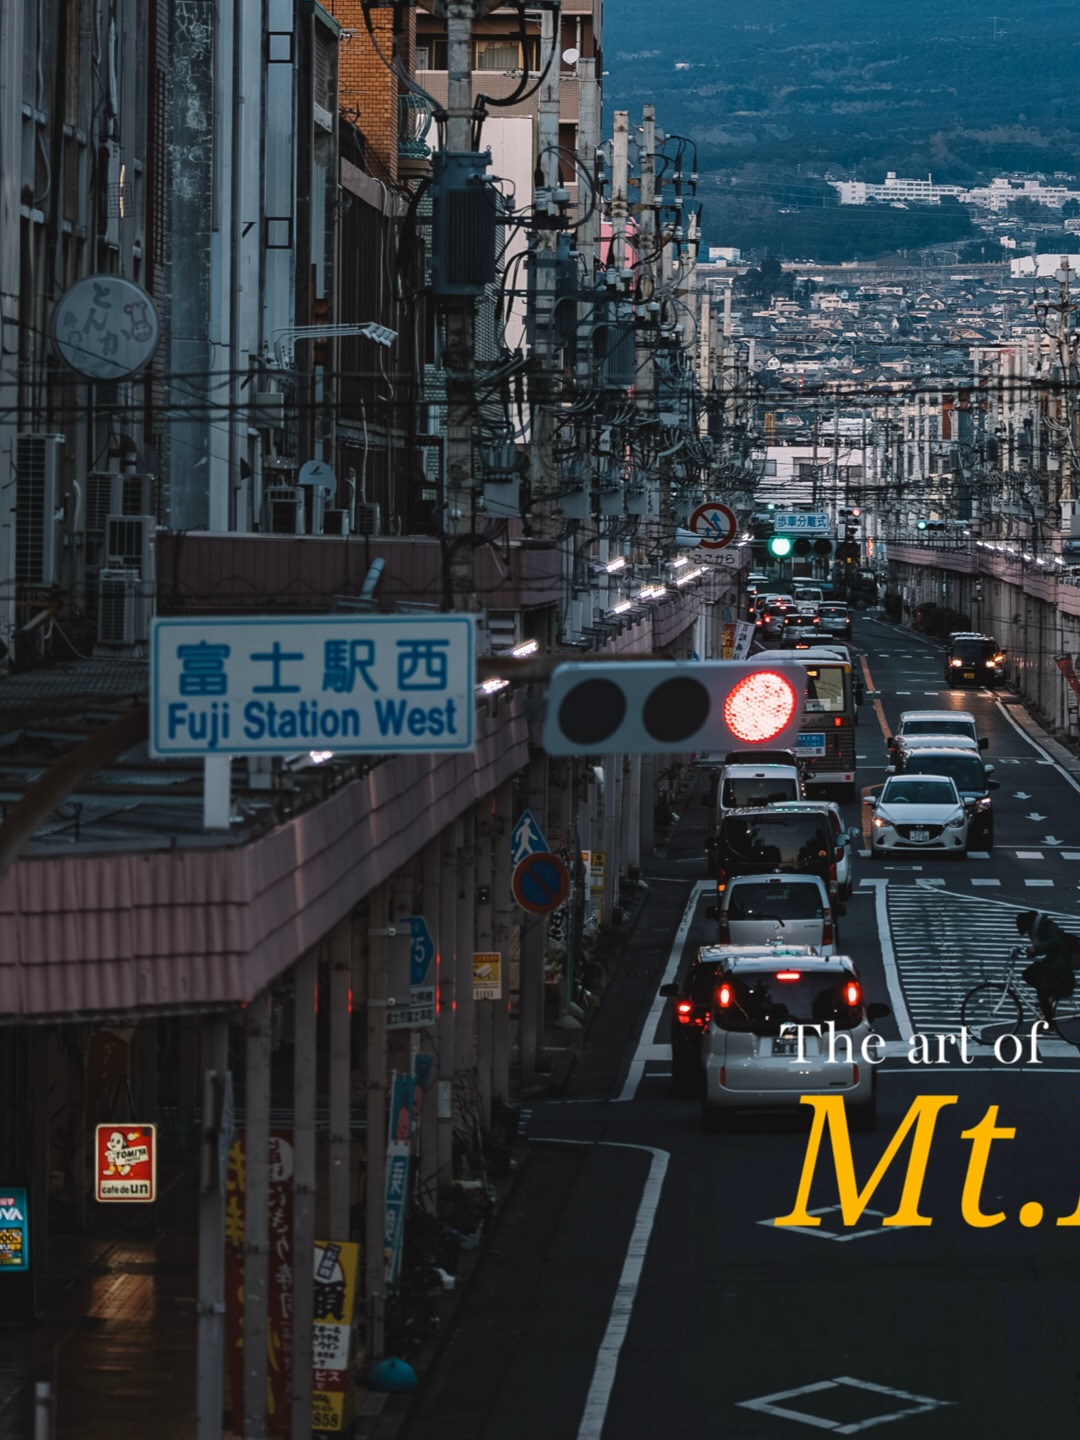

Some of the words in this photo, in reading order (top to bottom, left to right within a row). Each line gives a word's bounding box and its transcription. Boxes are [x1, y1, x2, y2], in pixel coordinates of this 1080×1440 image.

[777, 515, 828, 528] 歩車分離式
[693, 553, 735, 565] ここから
[177, 639, 450, 697] 富士駅西
[168, 703, 230, 748] Fuji
[244, 699, 360, 740] Station
[374, 698, 457, 736] West
[116, 1148, 146, 1159] TOMIYA
[130, 1184, 148, 1194] un
